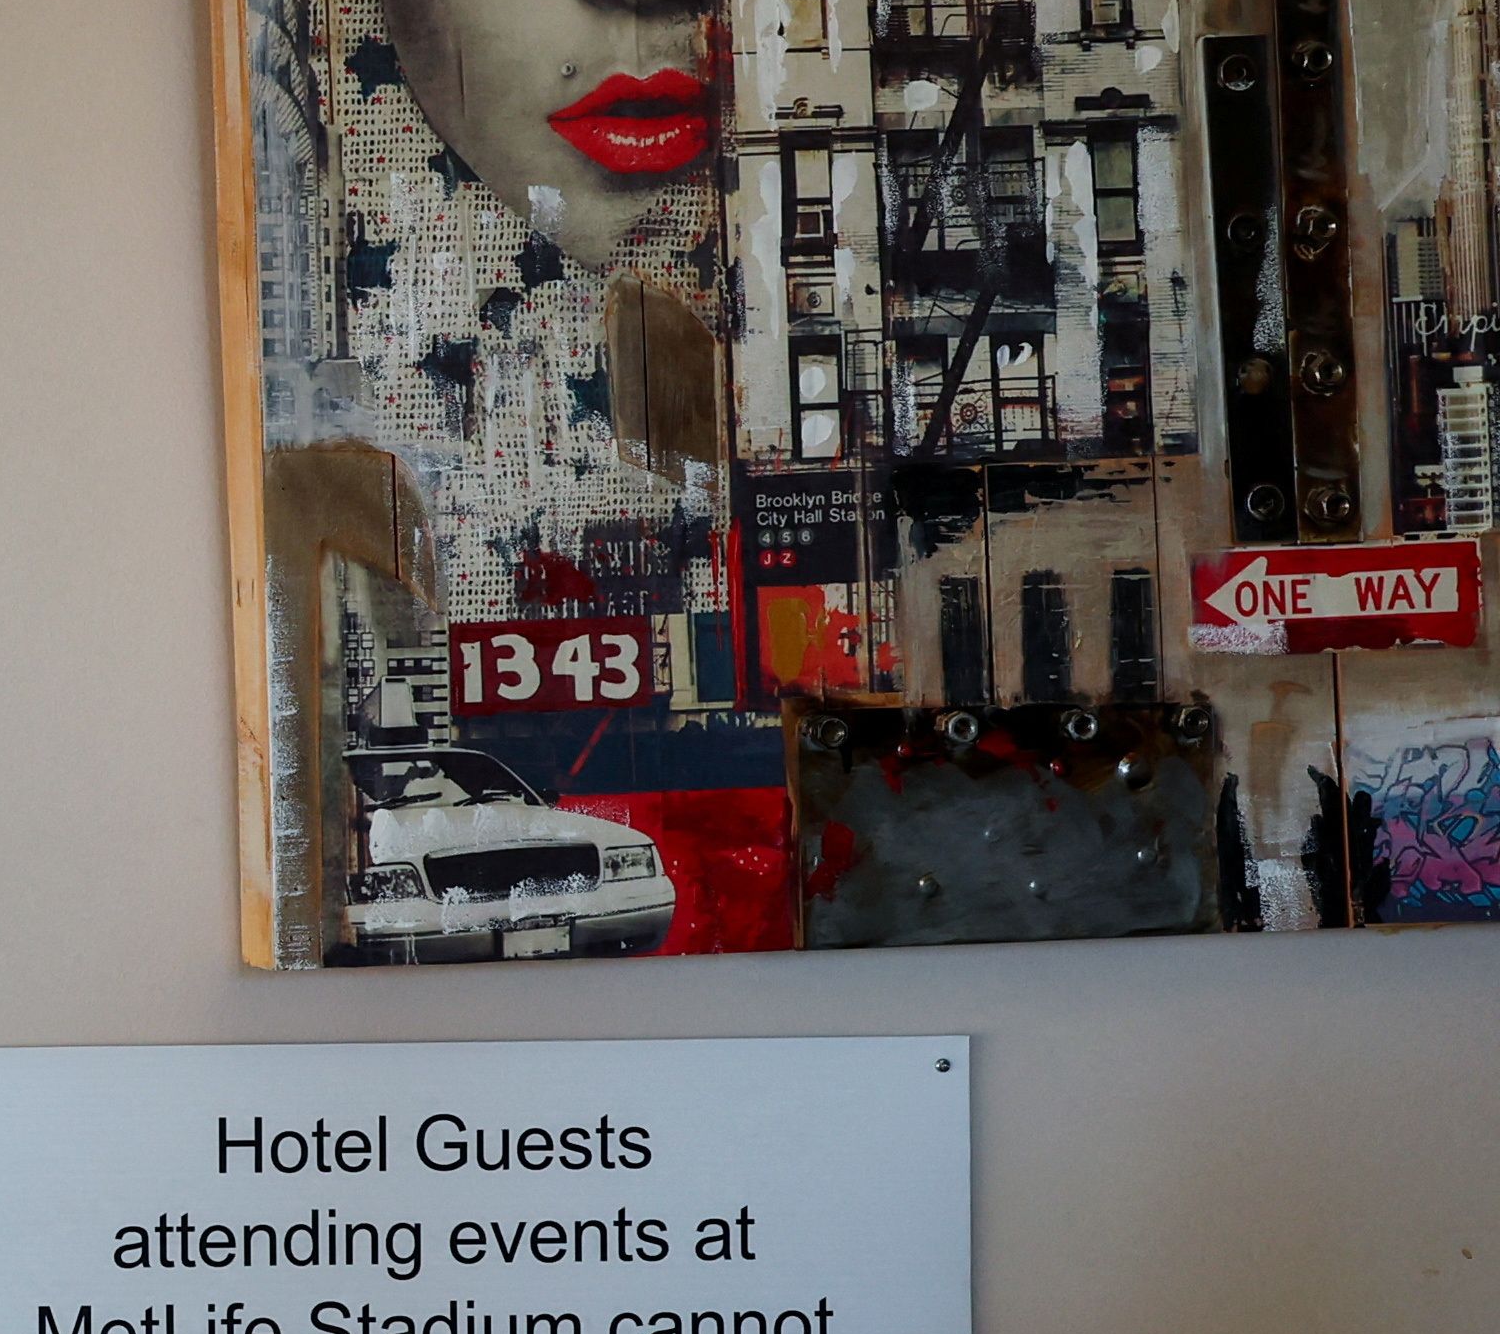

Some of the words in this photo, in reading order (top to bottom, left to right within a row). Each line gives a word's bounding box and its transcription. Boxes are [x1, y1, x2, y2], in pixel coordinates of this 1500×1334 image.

[755, 492, 825, 510] Brooklyn
[756, 511, 788, 528] City
[794, 510, 823, 524] Hall
[1235, 578, 1312, 617] ONE
[1354, 572, 1441, 611] WAY
[460, 633, 641, 703] 1343
[218, 1114, 387, 1174] Hotel
[415, 1113, 652, 1172] Guests
[113, 1208, 422, 1281] attending
[449, 1206, 670, 1265] events
[694, 1205, 757, 1262] at
